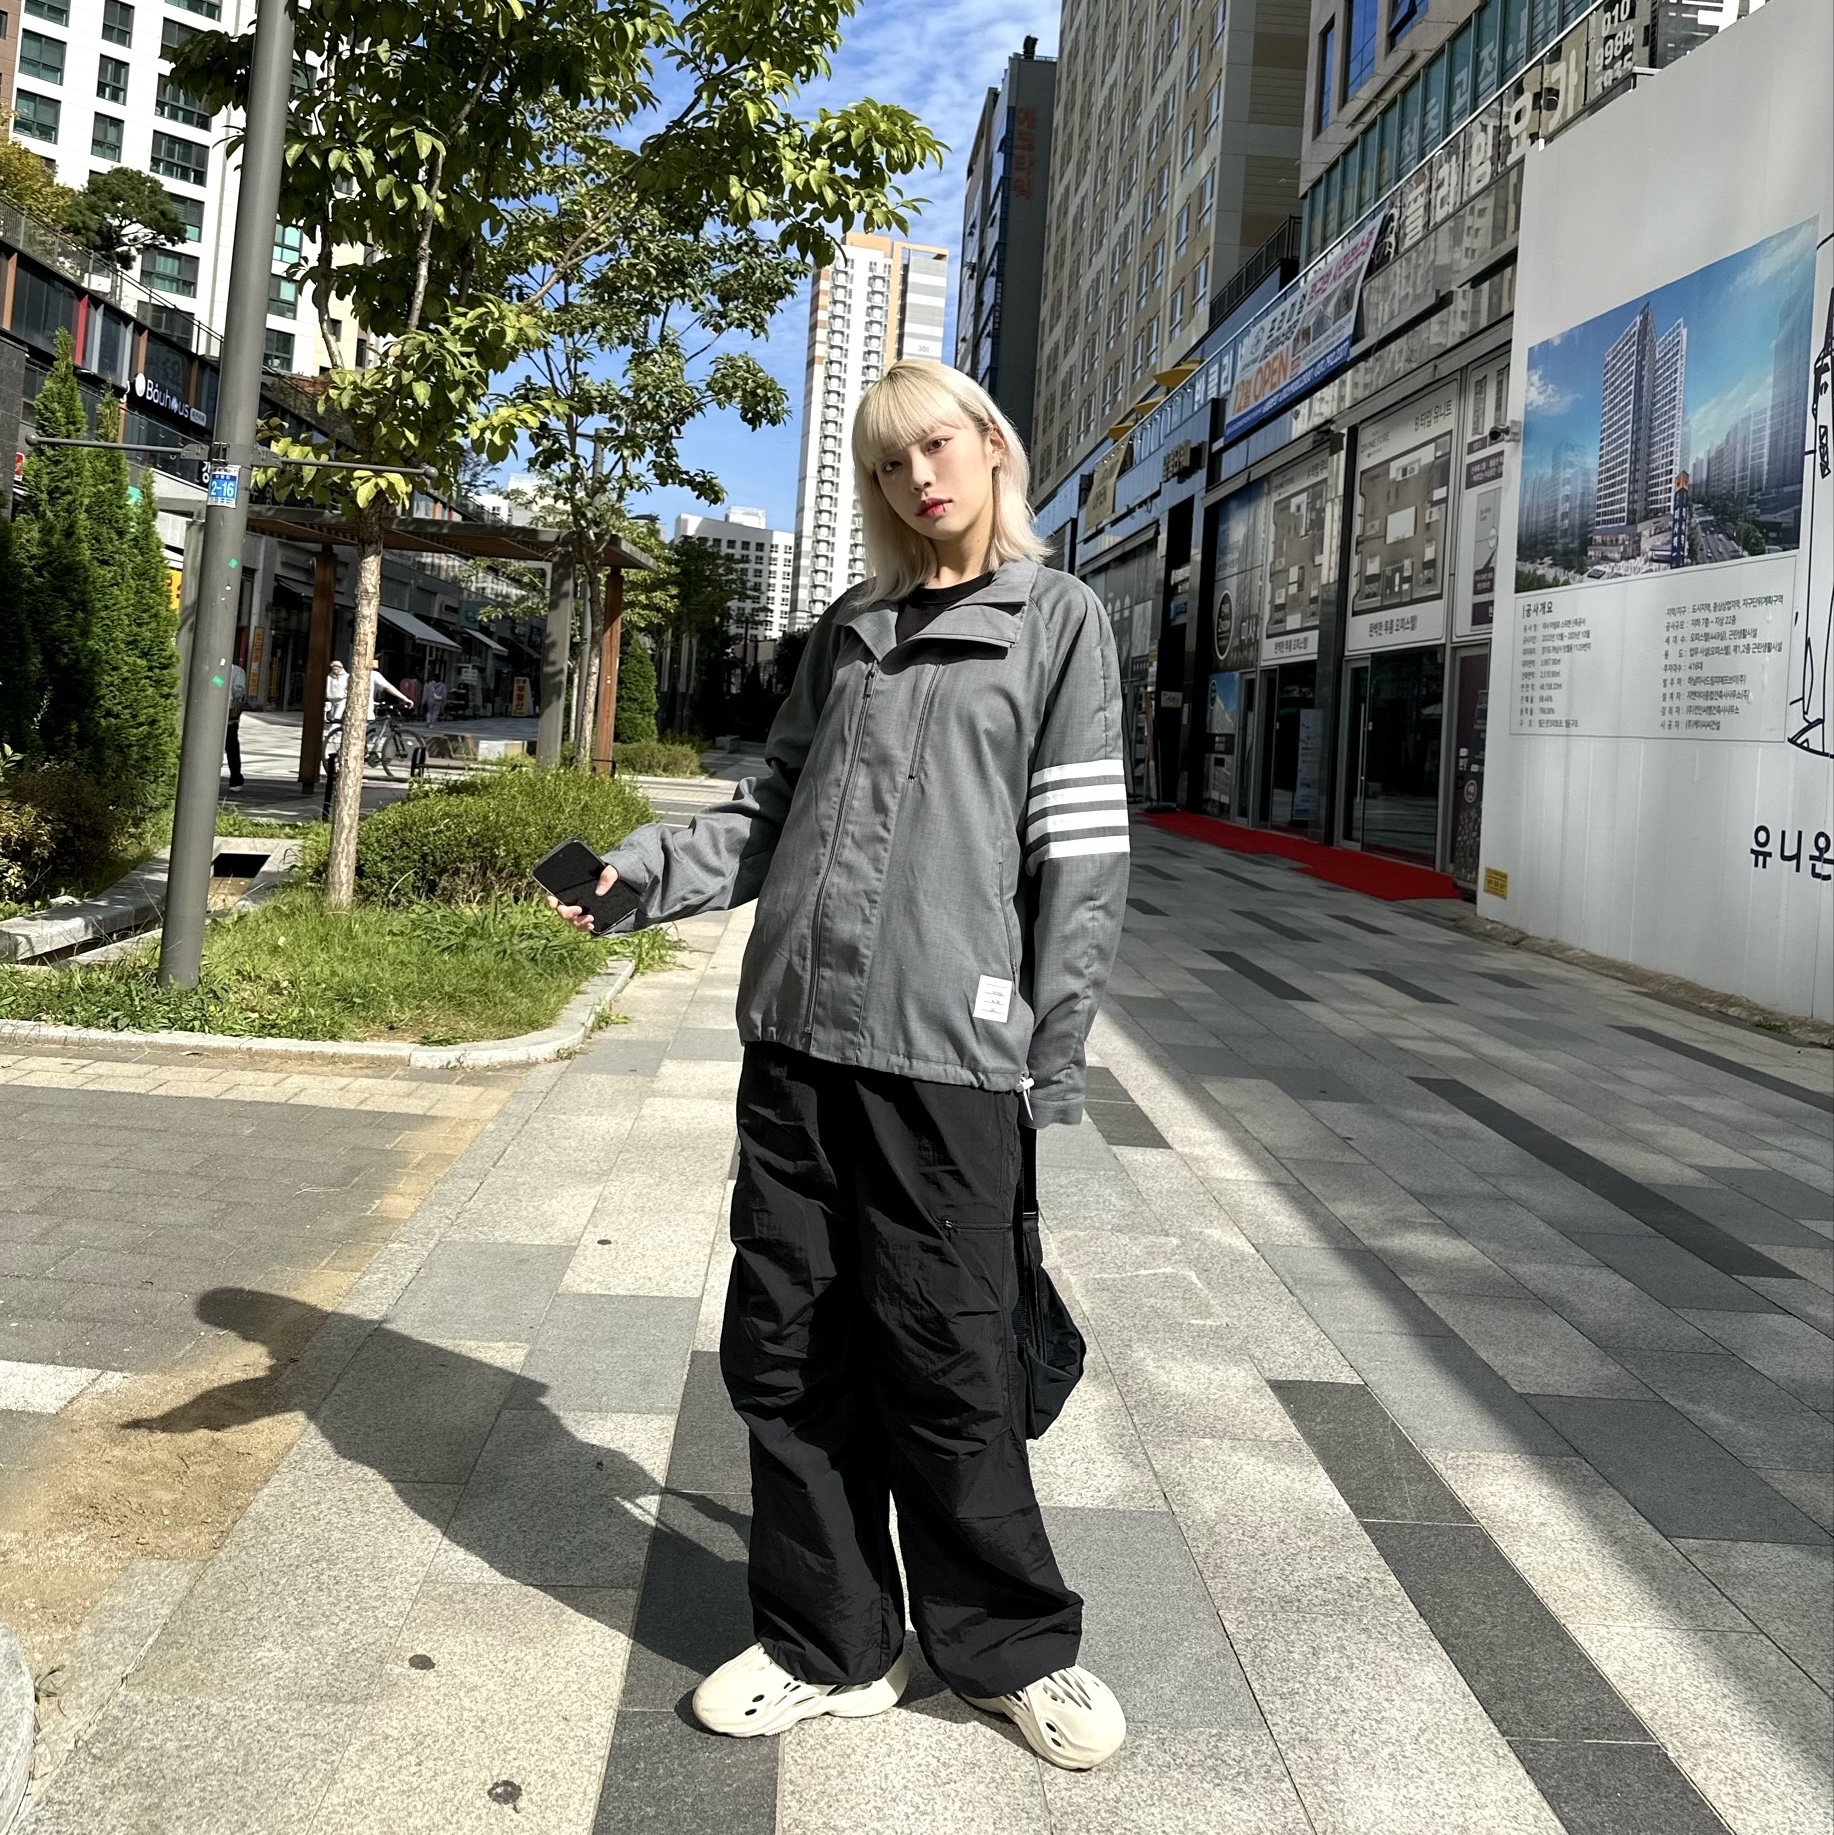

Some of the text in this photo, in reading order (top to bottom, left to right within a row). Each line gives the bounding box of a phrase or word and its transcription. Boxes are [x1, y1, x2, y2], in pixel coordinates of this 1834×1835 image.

[1601, 0, 1631, 37] 010
[1595, 23, 1634, 73] 9984
[1253, 345, 1290, 403] OPEN
[210, 480, 235, 498] 2-16
[1525, 600, 1553, 618] 공사개요
[1749, 825, 1834, 881] 유니온
